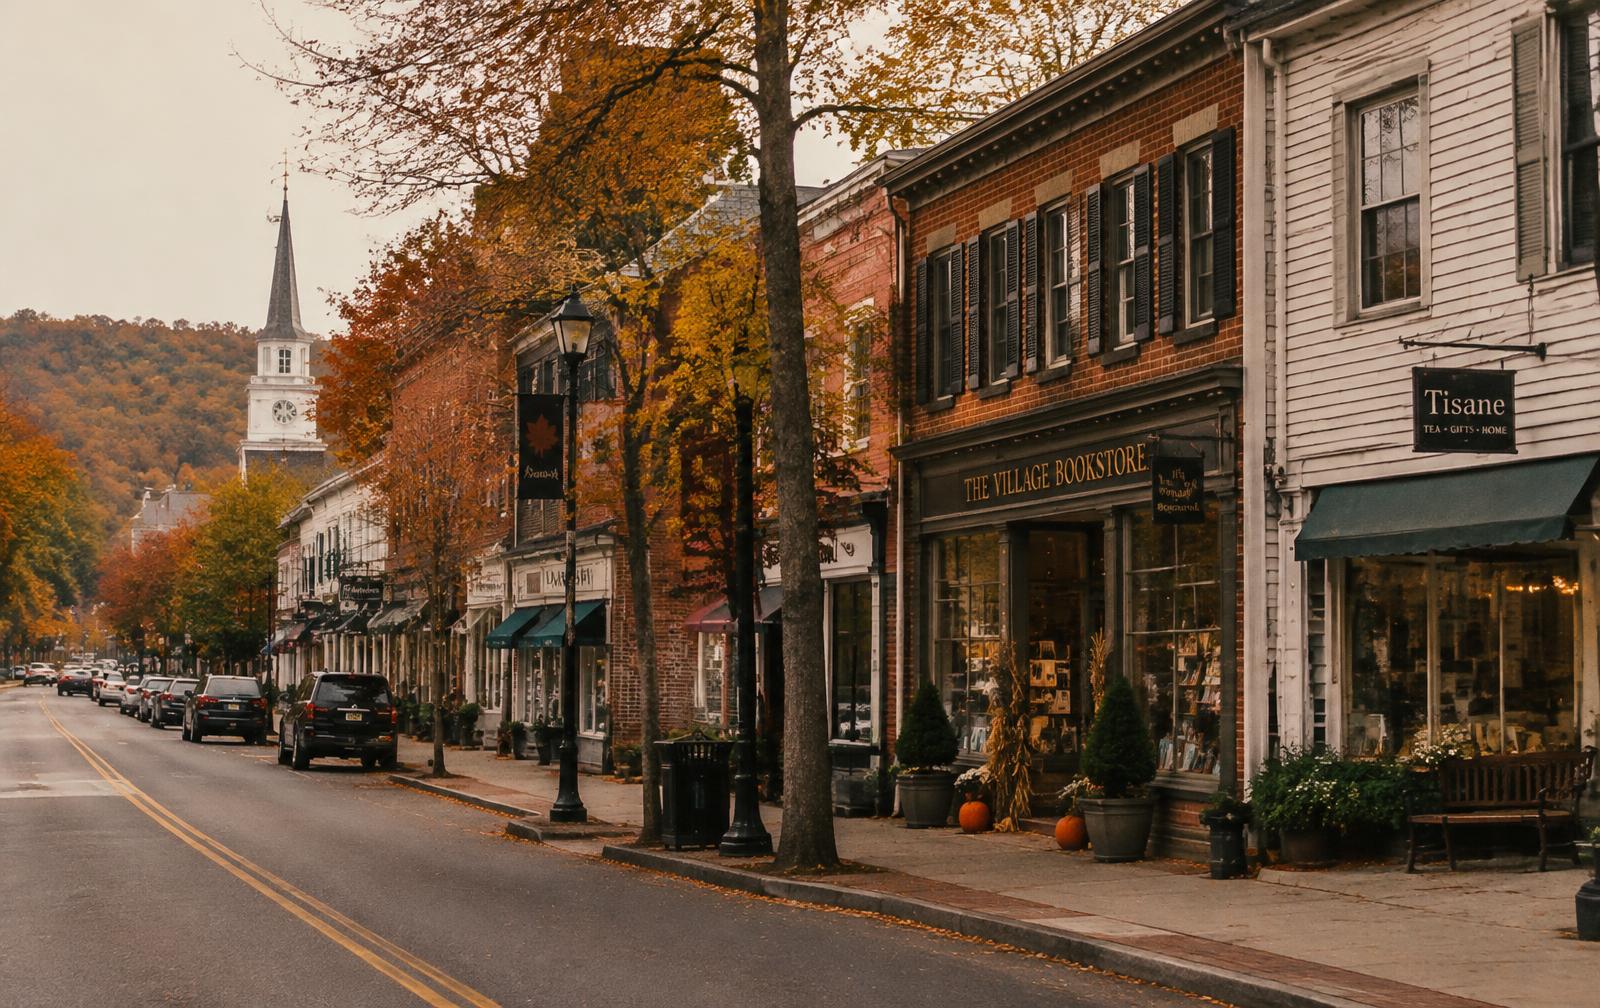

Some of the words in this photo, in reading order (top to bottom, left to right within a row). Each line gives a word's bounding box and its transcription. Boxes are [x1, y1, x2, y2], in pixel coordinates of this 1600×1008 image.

[1424, 389, 1505, 416] Tisane
[1423, 424, 1441, 434] TEA
[1450, 425, 1475, 434] GIFTS
[1482, 425, 1508, 435] HOME
[964, 477, 990, 503] THE
[993, 462, 1049, 497] VILLAGE
